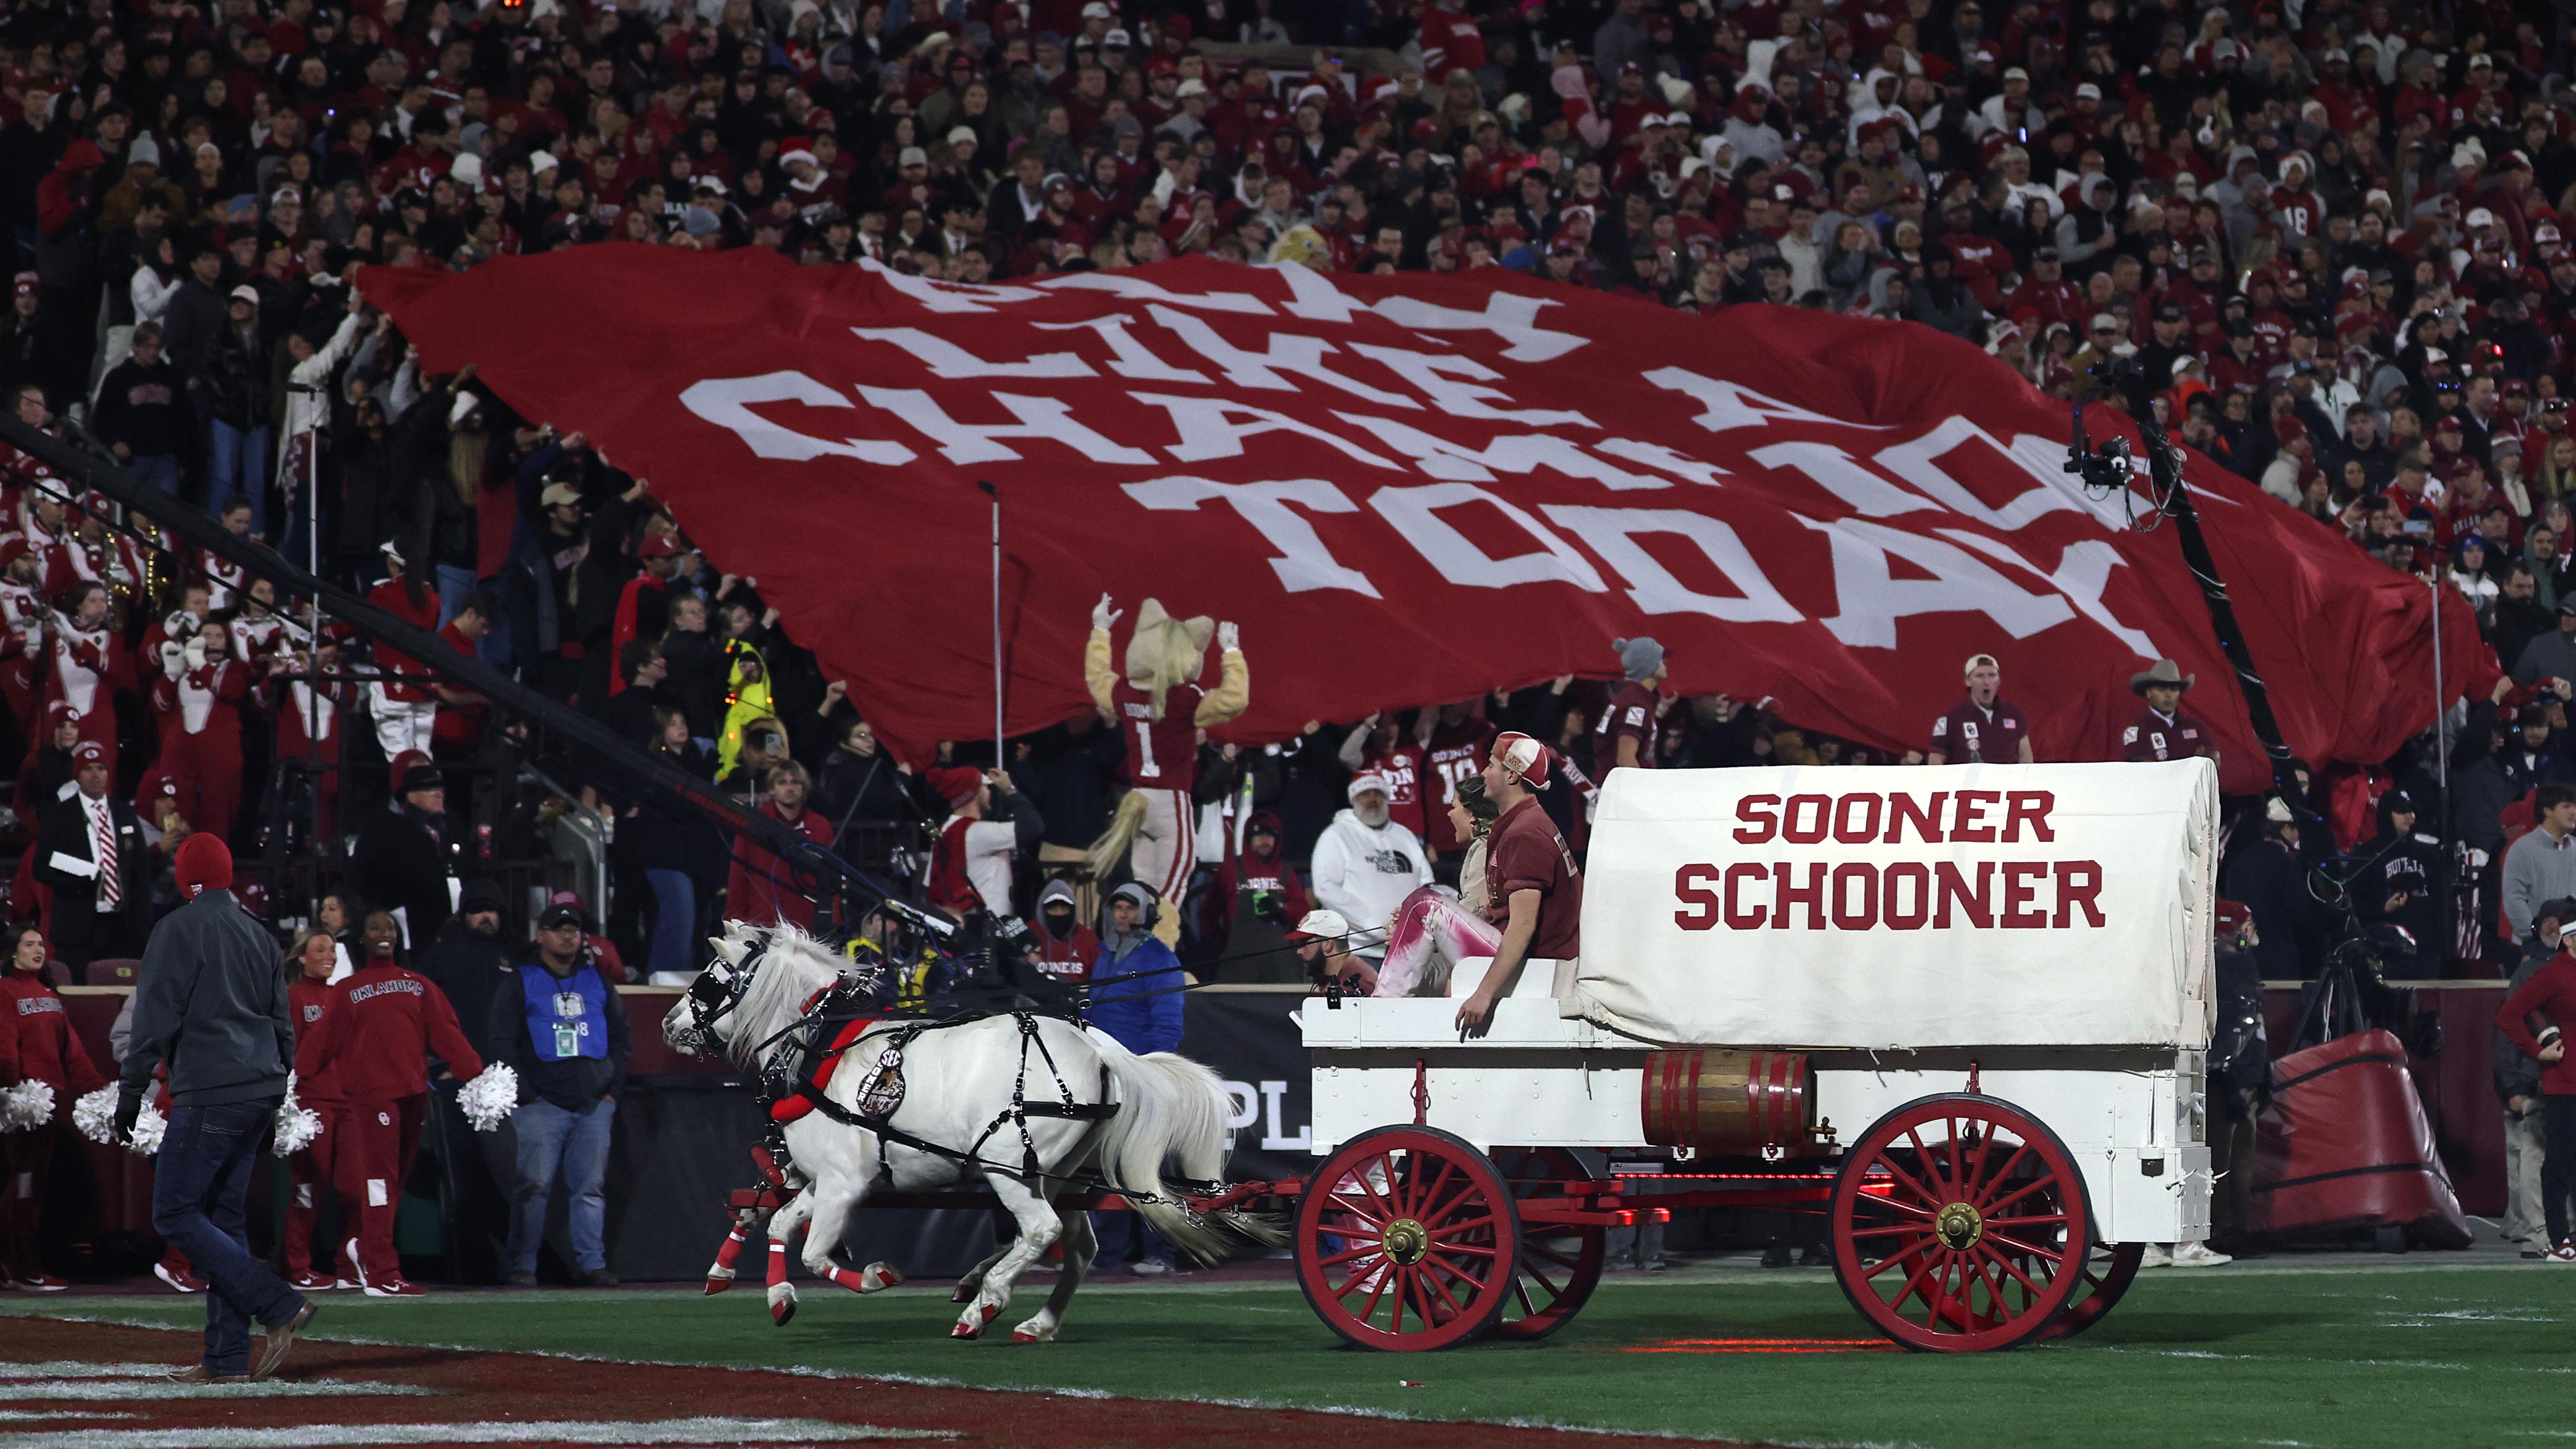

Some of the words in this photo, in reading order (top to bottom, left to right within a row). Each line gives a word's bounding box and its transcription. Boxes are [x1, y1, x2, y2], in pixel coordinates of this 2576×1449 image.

[849, 304, 1604, 430] LIKE
[1641, 366, 1903, 432] A
[1119, 475, 2164, 661] TODAY
[1135, 721, 1161, 778] 1
[1732, 790, 2056, 845] SOONER
[1675, 860, 2106, 931] SCHOONER
[350, 980, 425, 1004] OKLAHOMA
[1036, 961, 1084, 975] OONERS
[880, 1049, 902, 1067] SEC
